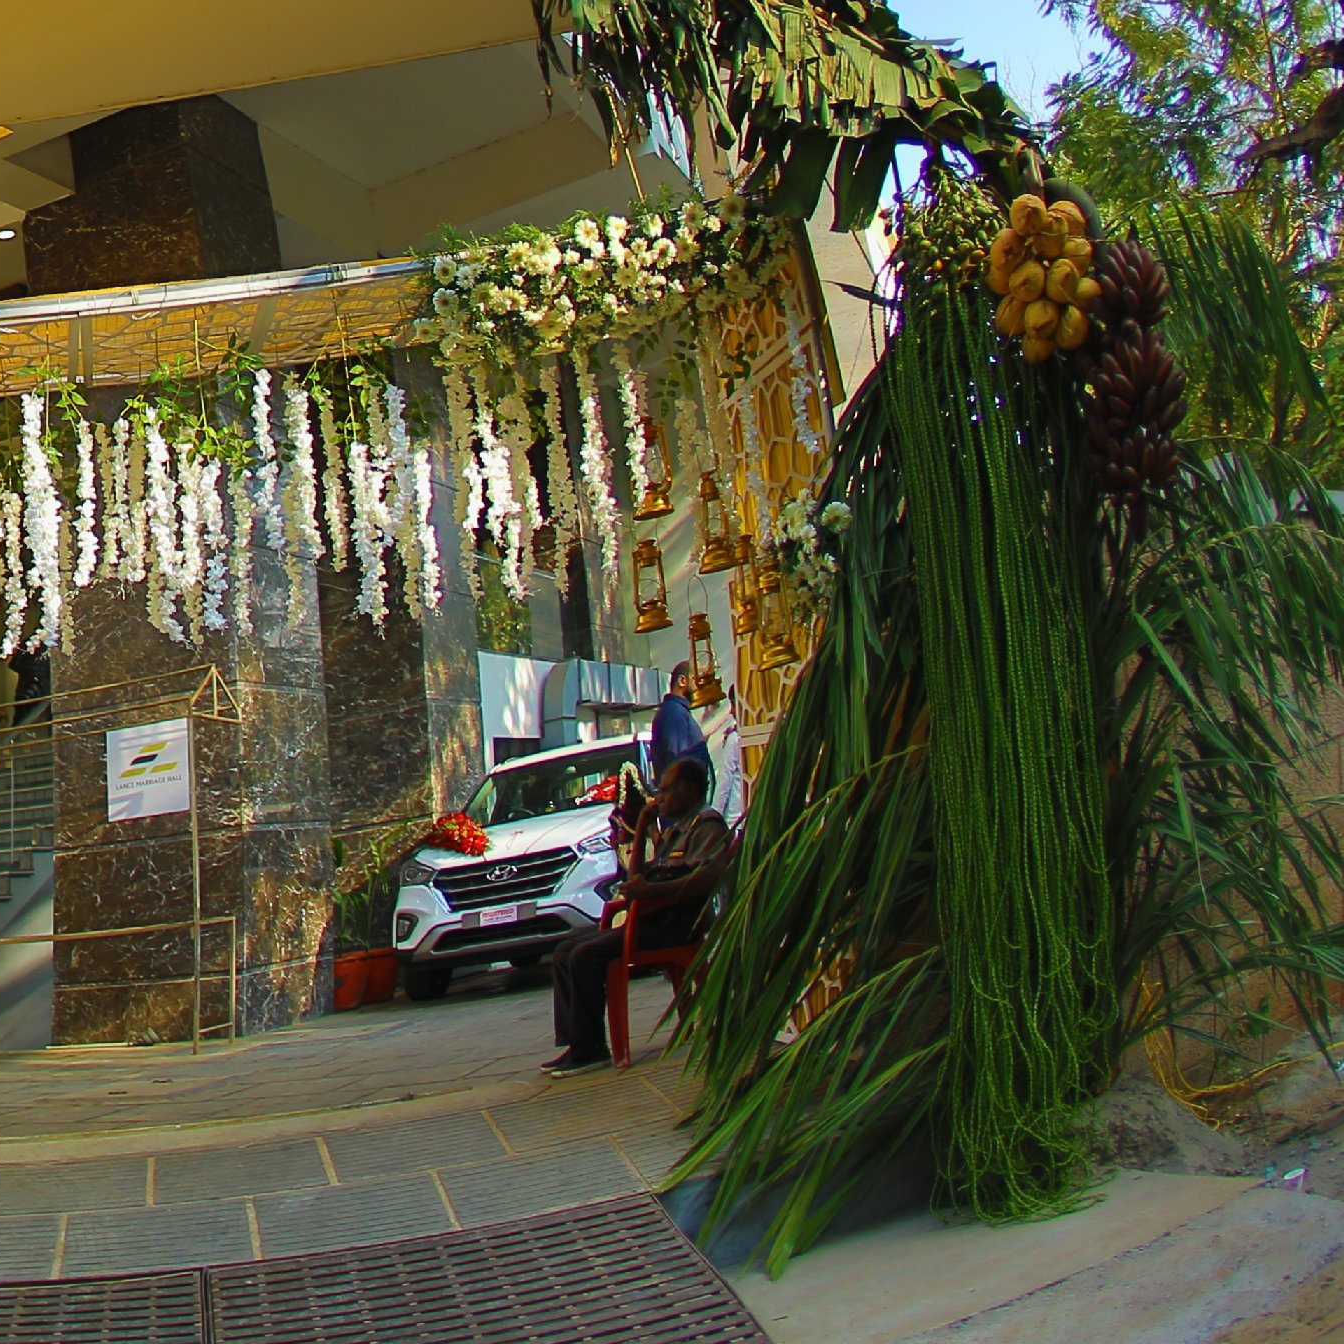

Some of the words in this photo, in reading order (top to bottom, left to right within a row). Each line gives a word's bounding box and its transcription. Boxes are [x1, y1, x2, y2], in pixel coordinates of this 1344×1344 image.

[116, 782, 134, 791] LANCE
[135, 777, 166, 788] MARRIAGE
[167, 775, 182, 783] HALL
